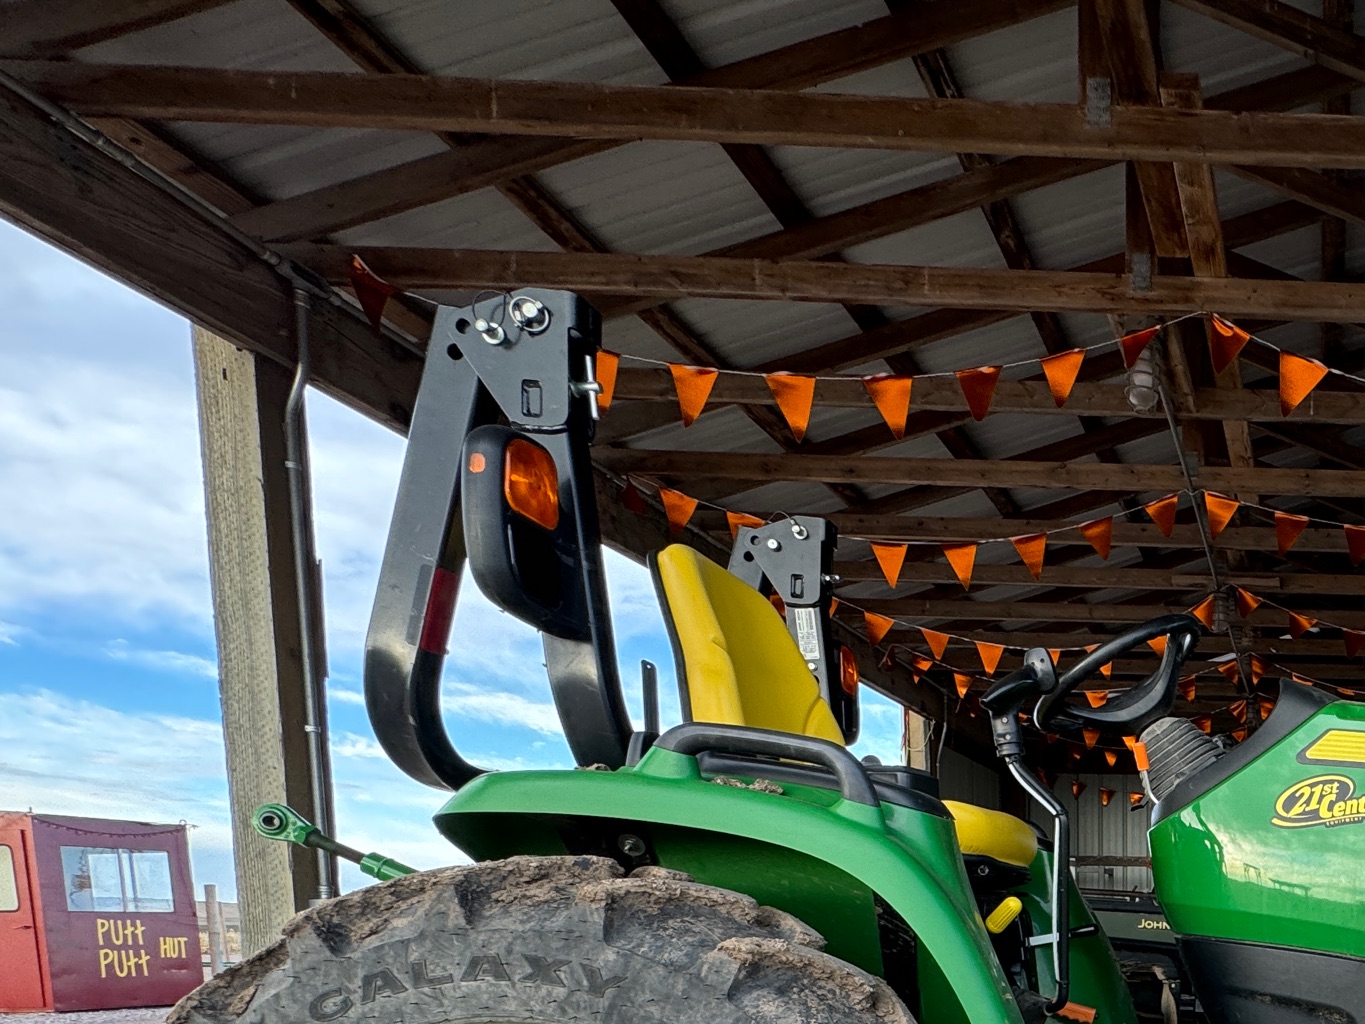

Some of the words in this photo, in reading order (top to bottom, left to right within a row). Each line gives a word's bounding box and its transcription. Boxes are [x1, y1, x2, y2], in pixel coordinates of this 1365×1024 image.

[1138, 919, 1171, 930] JOHN
[159, 936, 189, 959] HUT
[308, 952, 628, 1022] GALAXY
